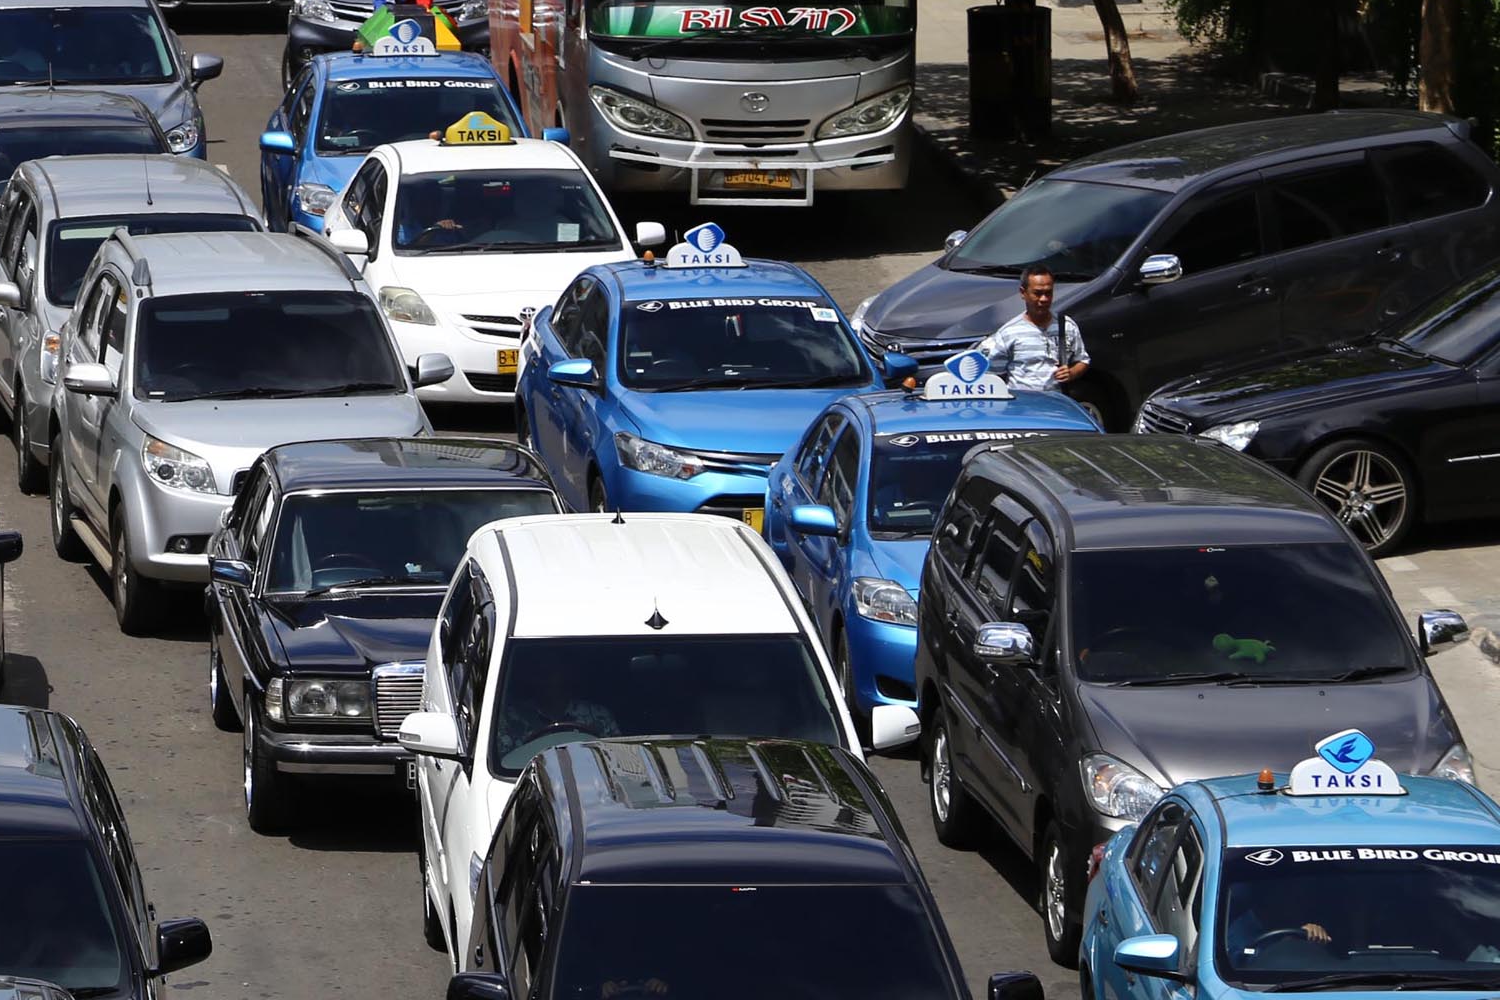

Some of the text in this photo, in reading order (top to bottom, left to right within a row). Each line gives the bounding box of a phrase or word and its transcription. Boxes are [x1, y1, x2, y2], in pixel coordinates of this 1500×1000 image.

[383, 44, 426, 53] TAKSI
[368, 80, 494, 89] BLUE BIRD GROUP
[457, 130, 502, 141] TAKSI
[681, 254, 731, 264] TAKSI
[668, 301, 712, 310] BLUE
[758, 299, 817, 309] GROUP
[500, 350, 507, 364] B
[940, 384, 995, 395] TAKSI
[925, 434, 973, 443] BLUE
[1311, 774, 1383, 788] TAKSI
[1292, 849, 1500, 864] BLUE BIRD GROU
